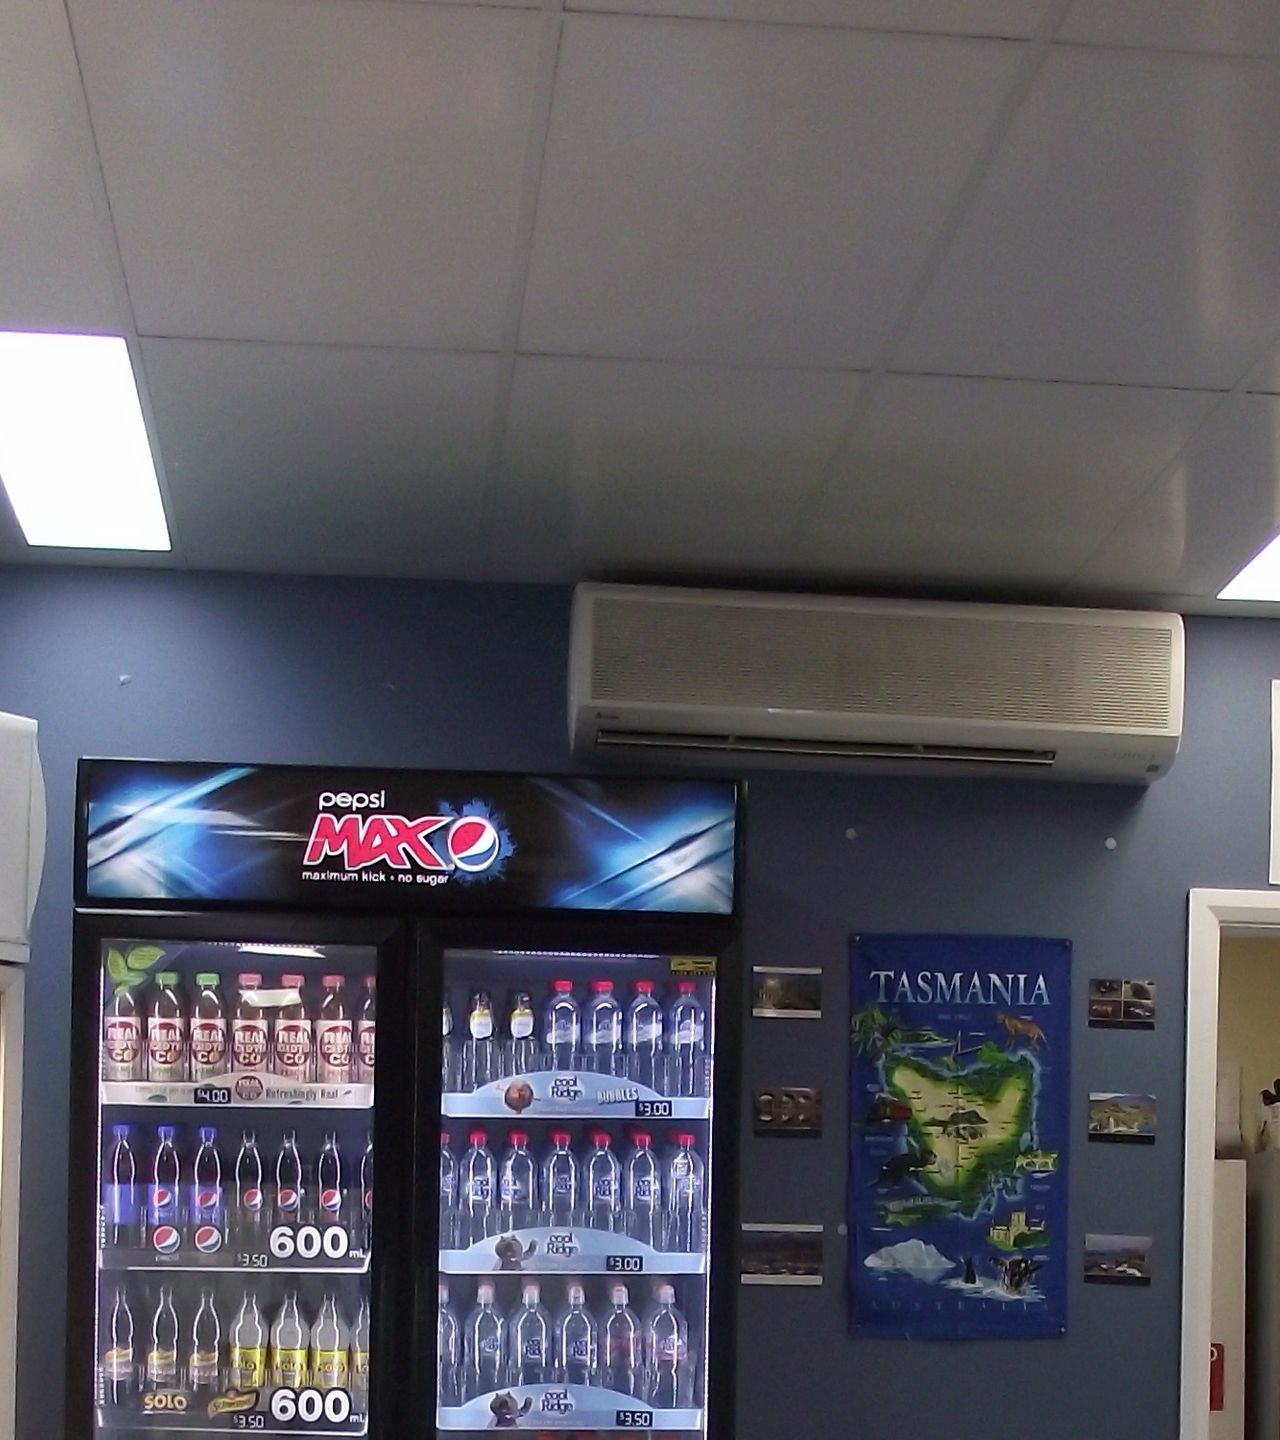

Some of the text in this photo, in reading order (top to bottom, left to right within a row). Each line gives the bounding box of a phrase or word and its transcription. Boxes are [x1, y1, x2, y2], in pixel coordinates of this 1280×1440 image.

[319, 790, 385, 811] pepsi
[303, 813, 455, 870] MAX
[302, 870, 449, 886] maximum kick no sugar
[869, 970, 1051, 1006] TASMANIA
[554, 1075, 578, 1087] cool
[551, 1087, 583, 1101] Ridge
[639, 1102, 670, 1114] $3.00
[269, 1225, 349, 1259] 600
[549, 1232, 573, 1244] cool
[144, 1393, 188, 1411] SOLO
[545, 1389, 568, 1401] cool
[270, 1388, 351, 1422] 600
[541, 1400, 575, 1415] Ridge
[619, 1412, 650, 1426] $3.50
